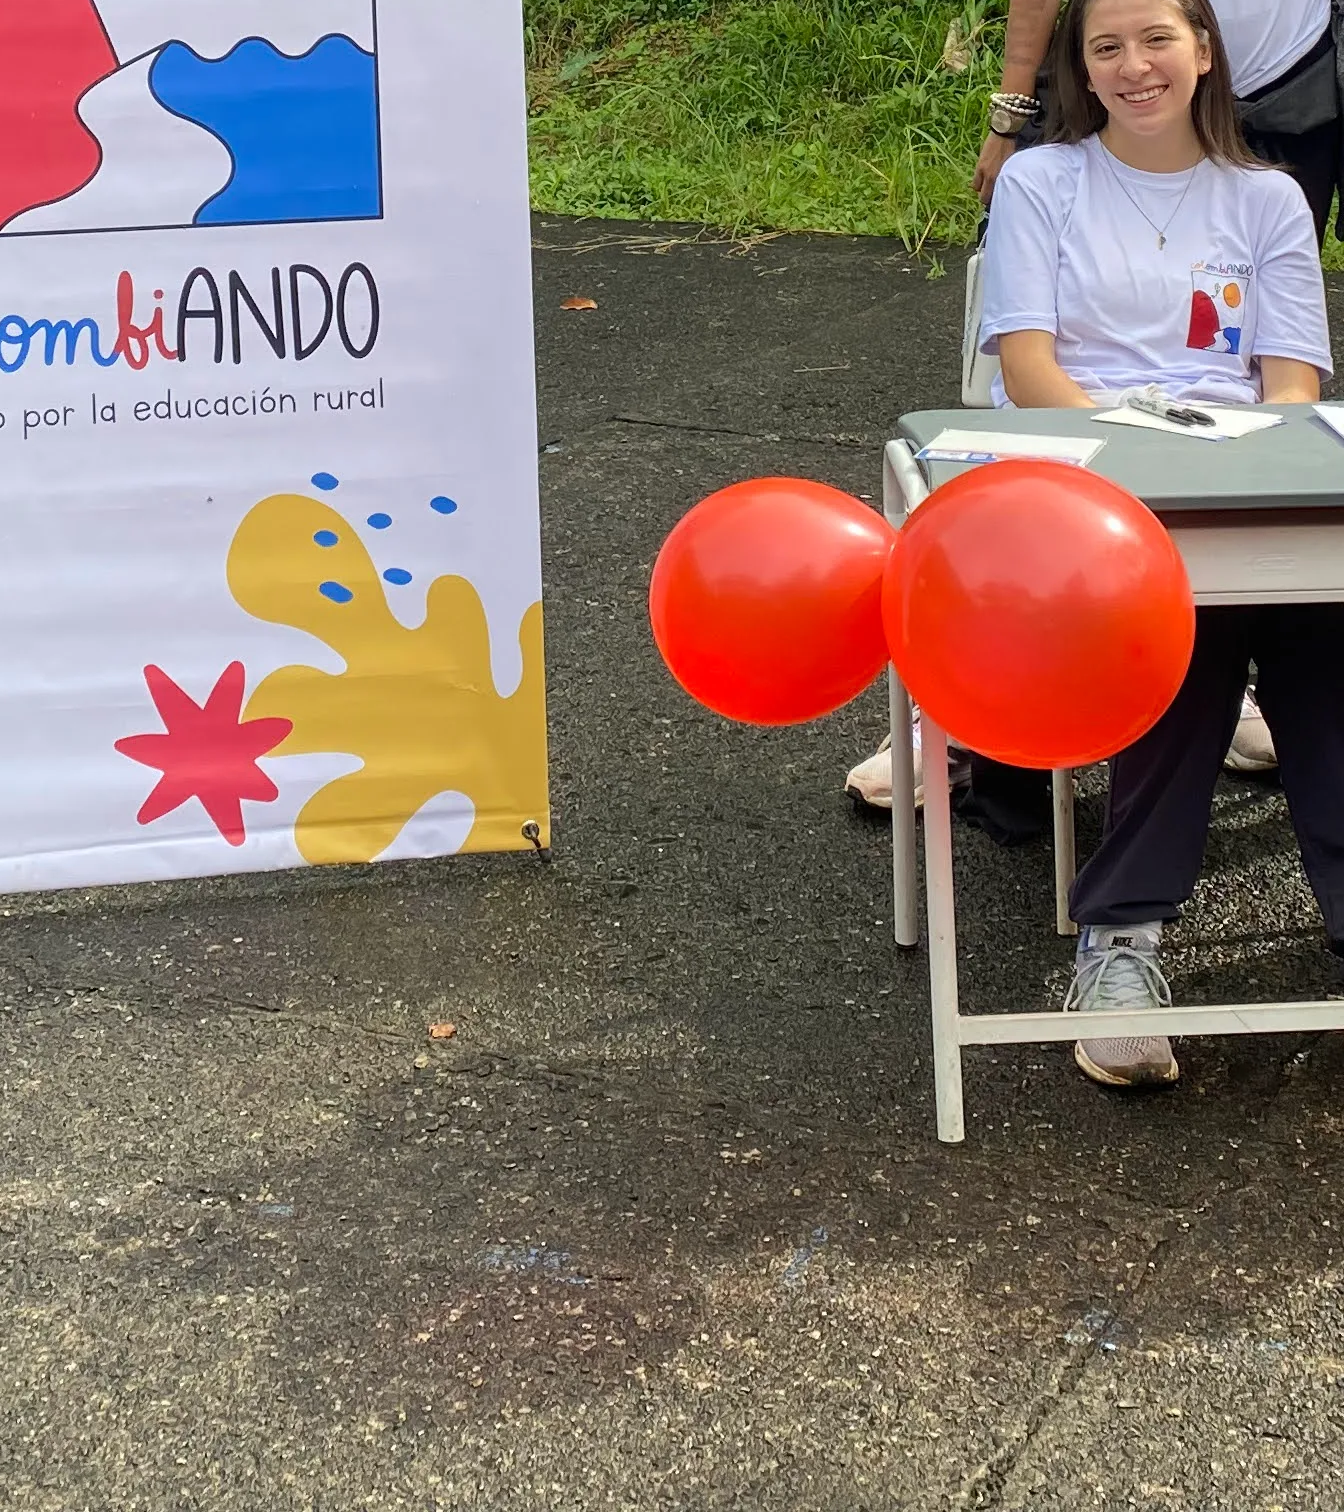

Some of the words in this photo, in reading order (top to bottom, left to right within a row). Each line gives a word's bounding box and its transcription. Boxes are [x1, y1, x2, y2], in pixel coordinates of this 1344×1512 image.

[23, 405, 75, 440] por
[92, 392, 117, 424] la
[133, 386, 297, 422] educación
[313, 377, 384, 412] rural
[1111, 935, 1134, 948] NIKE
